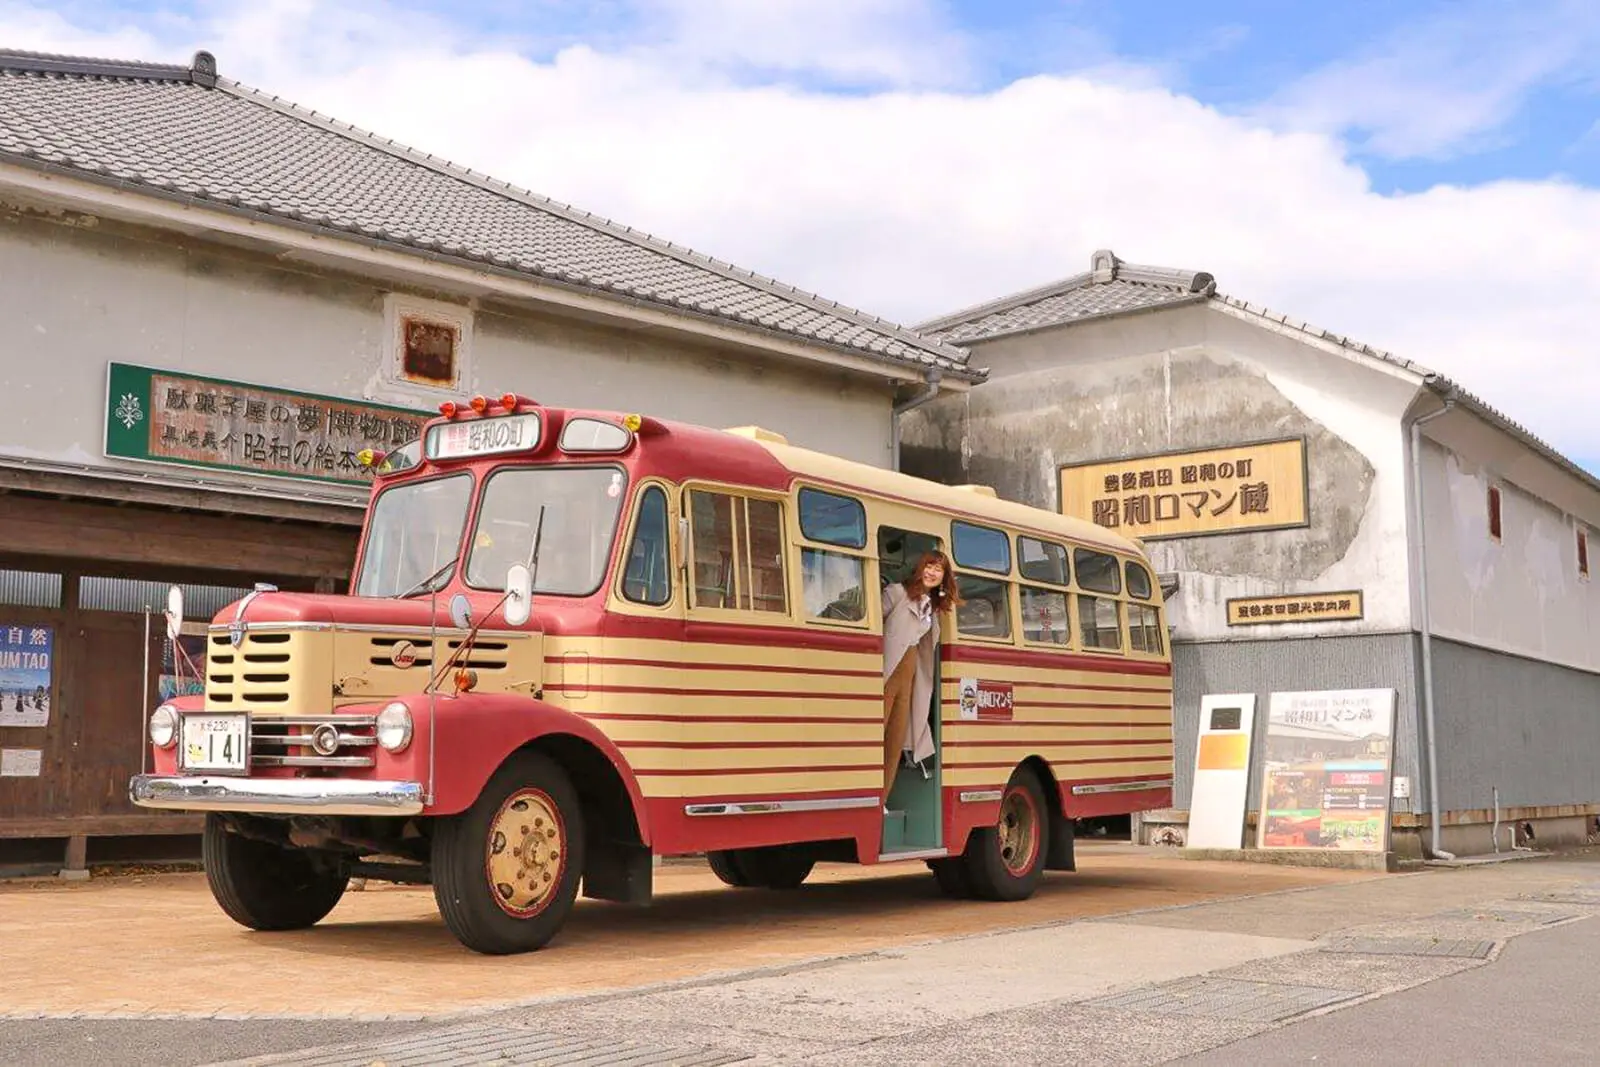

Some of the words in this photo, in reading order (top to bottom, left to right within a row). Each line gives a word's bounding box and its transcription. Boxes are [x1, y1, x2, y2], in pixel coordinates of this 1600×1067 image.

[165, 387, 420, 446] 駄菓子屋の夢博物館
[468, 419, 525, 451] 昭和の町
[1104, 468, 1173, 493] 豊後高田
[1180, 458, 1253, 484] 昭和の町
[1091, 480, 1270, 529] 昭和ロマン蔵
[0, 627, 47, 645] 自然
